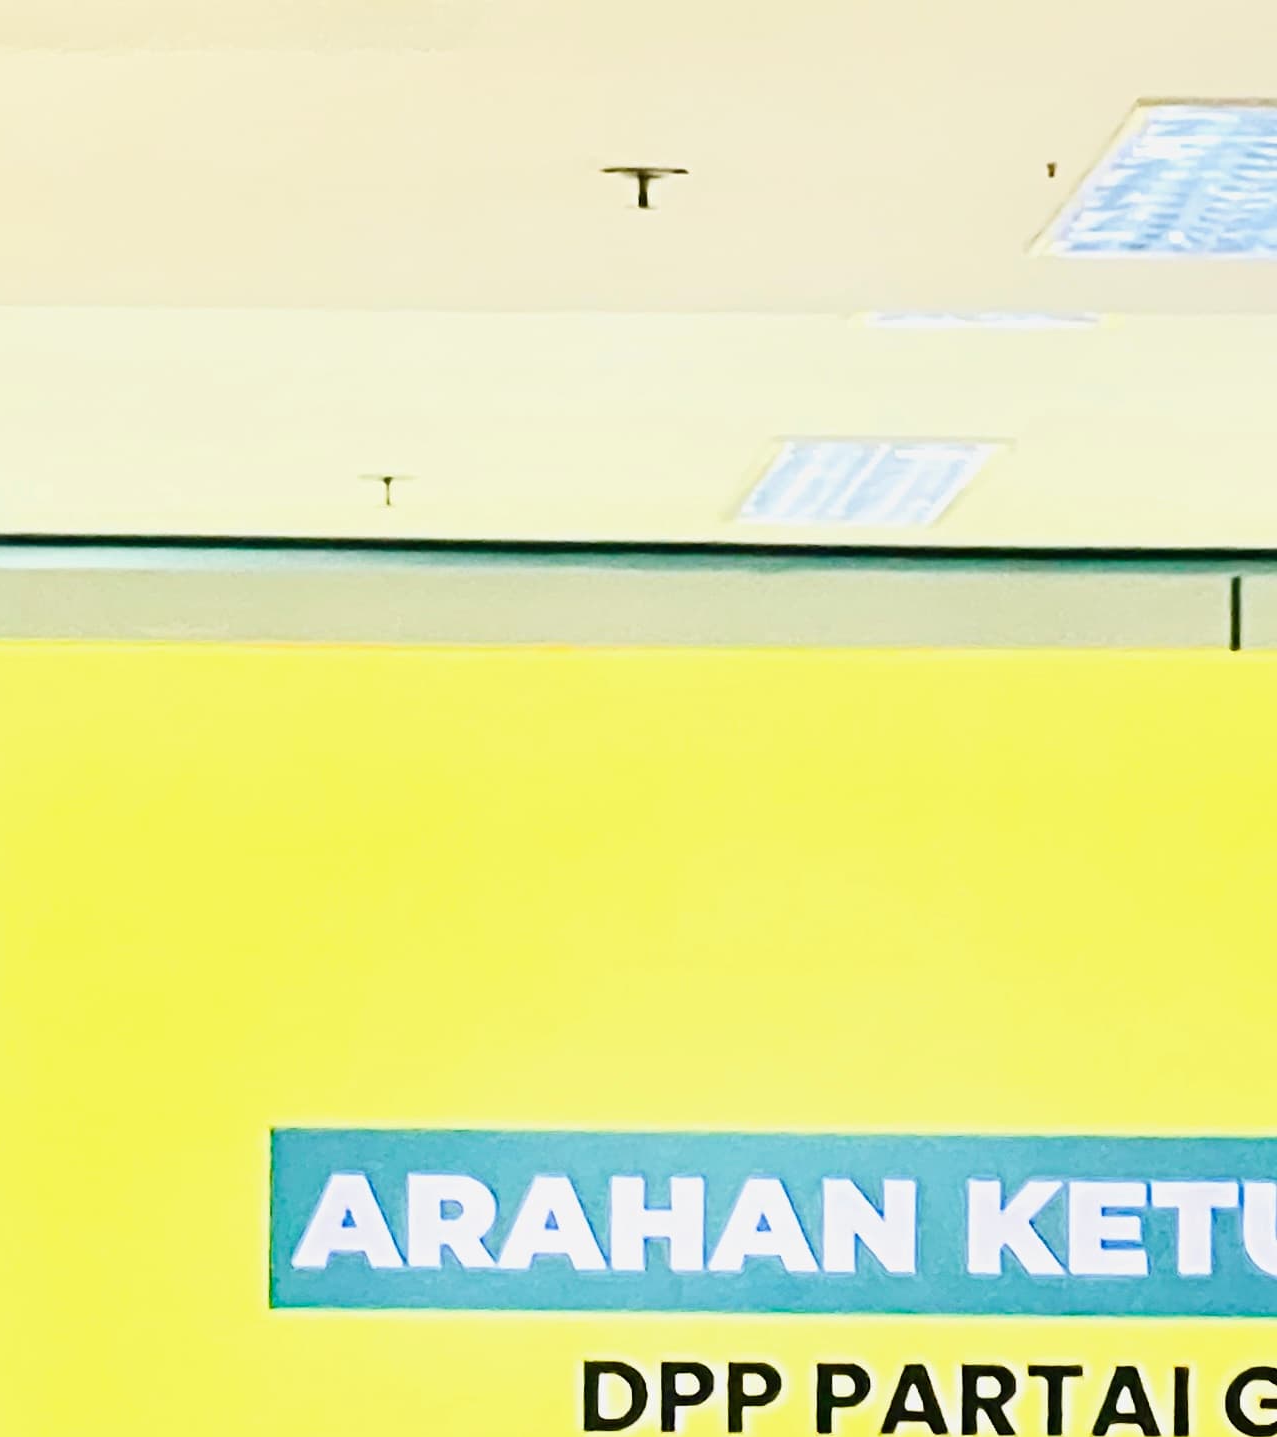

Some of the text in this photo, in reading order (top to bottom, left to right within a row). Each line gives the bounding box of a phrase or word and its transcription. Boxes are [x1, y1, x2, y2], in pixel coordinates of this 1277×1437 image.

[291, 1172, 918, 1276] ARAHAN
[583, 1360, 782, 1434] DPP
[815, 1362, 1190, 1437] PARTAI
